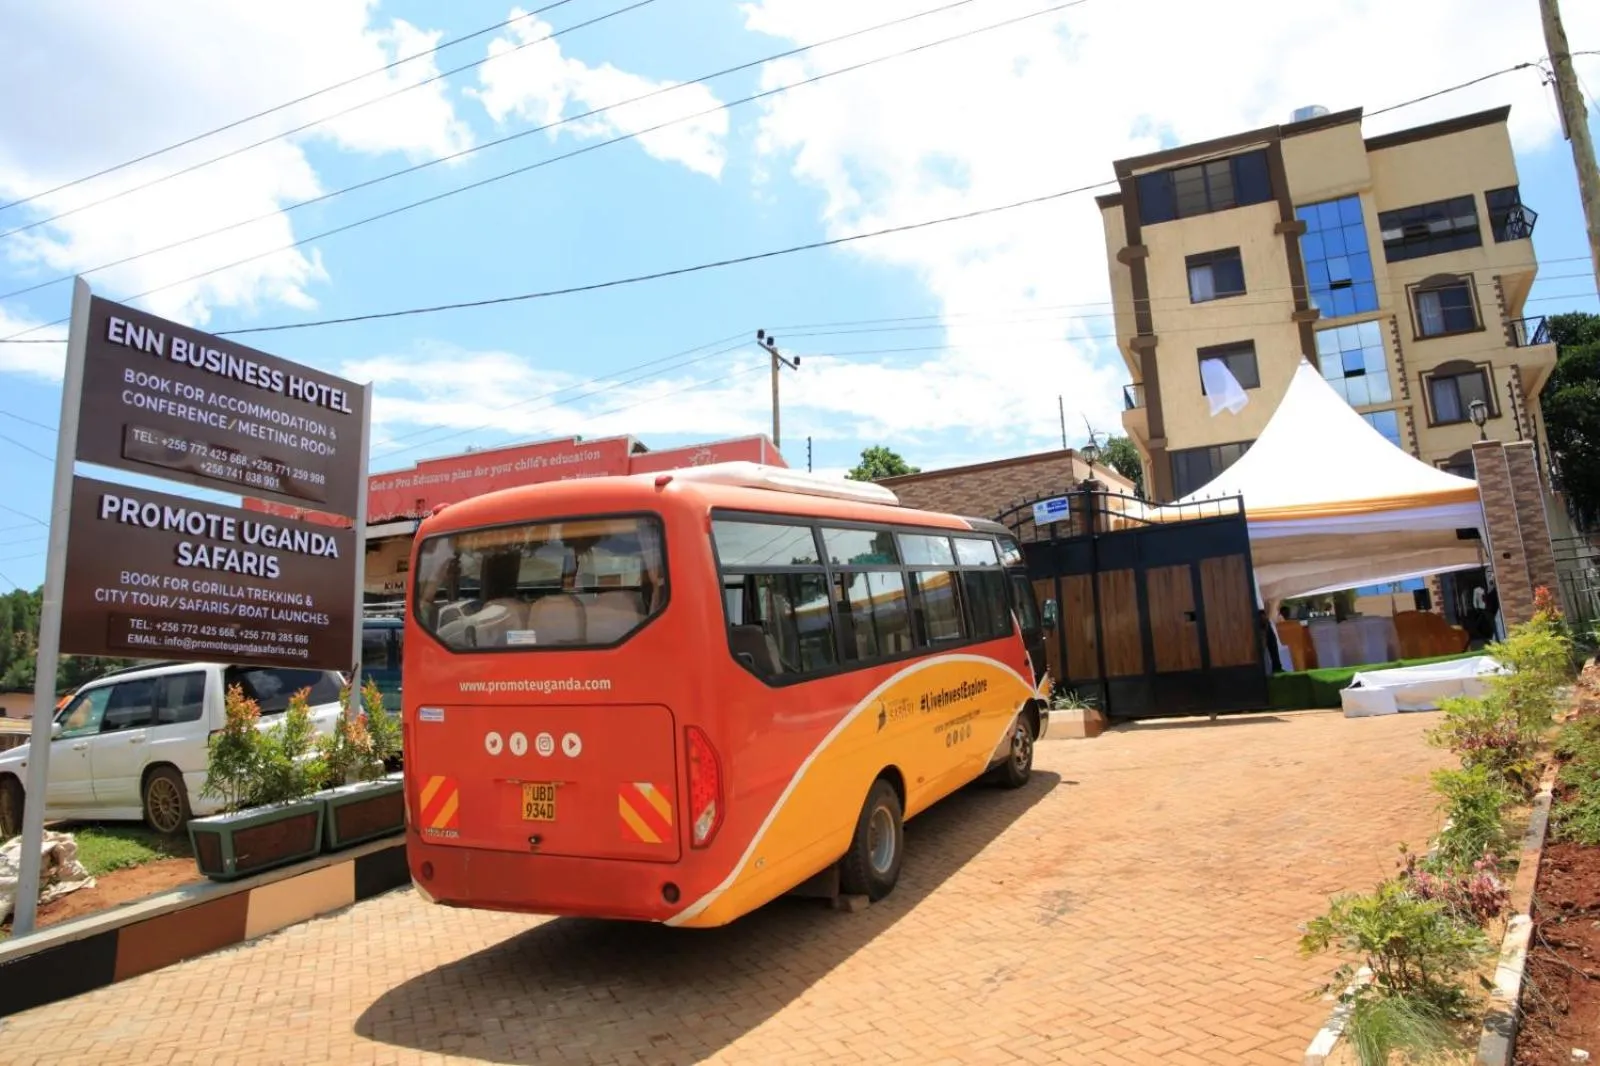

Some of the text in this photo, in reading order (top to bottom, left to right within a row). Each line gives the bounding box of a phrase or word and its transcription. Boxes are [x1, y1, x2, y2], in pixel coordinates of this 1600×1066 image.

[107, 316, 352, 414] ENN BUSINESS HOTEL
[124, 368, 171, 393] BOOK
[174, 382, 205, 403] FOR
[208, 393, 327, 436] ACCOMMODATION
[132, 428, 158, 445] TEL:
[162, 437, 188, 452] +256
[190, 443, 208, 457] 772
[209, 449, 228, 461] 425
[252, 458, 273, 473] +256
[275, 463, 290, 477] 771
[300, 436, 336, 456] ROOM
[200, 461, 224, 476] +256
[226, 466, 243, 480] 741
[491, 463, 513, 477] your
[514, 455, 548, 472] child's
[550, 449, 601, 466] education
[101, 494, 236, 541] PROMOTE
[243, 520, 339, 558] UGANDA
[177, 541, 280, 578] SAFARIS
[120, 571, 313, 607] BOOK FOR GORILLA TREKKING &
[95, 588, 128, 604] CITY
[271, 607, 330, 625] LAUNCHES
[129, 618, 153, 630] TEL:
[155, 621, 179, 633] +256
[181, 623, 199, 634] 772
[200, 625, 217, 637] 425
[239, 629, 259, 640] +256
[260, 631, 277, 641] 778
[127, 633, 309, 658] EMAIL: info@promoteugandasafaris.co.ug
[459, 677, 612, 696] www.promoteuganda.com
[920, 679, 988, 713] #LiveInvestExplore
[532, 786, 554, 801] UBD
[526, 803, 554, 819] 934D
